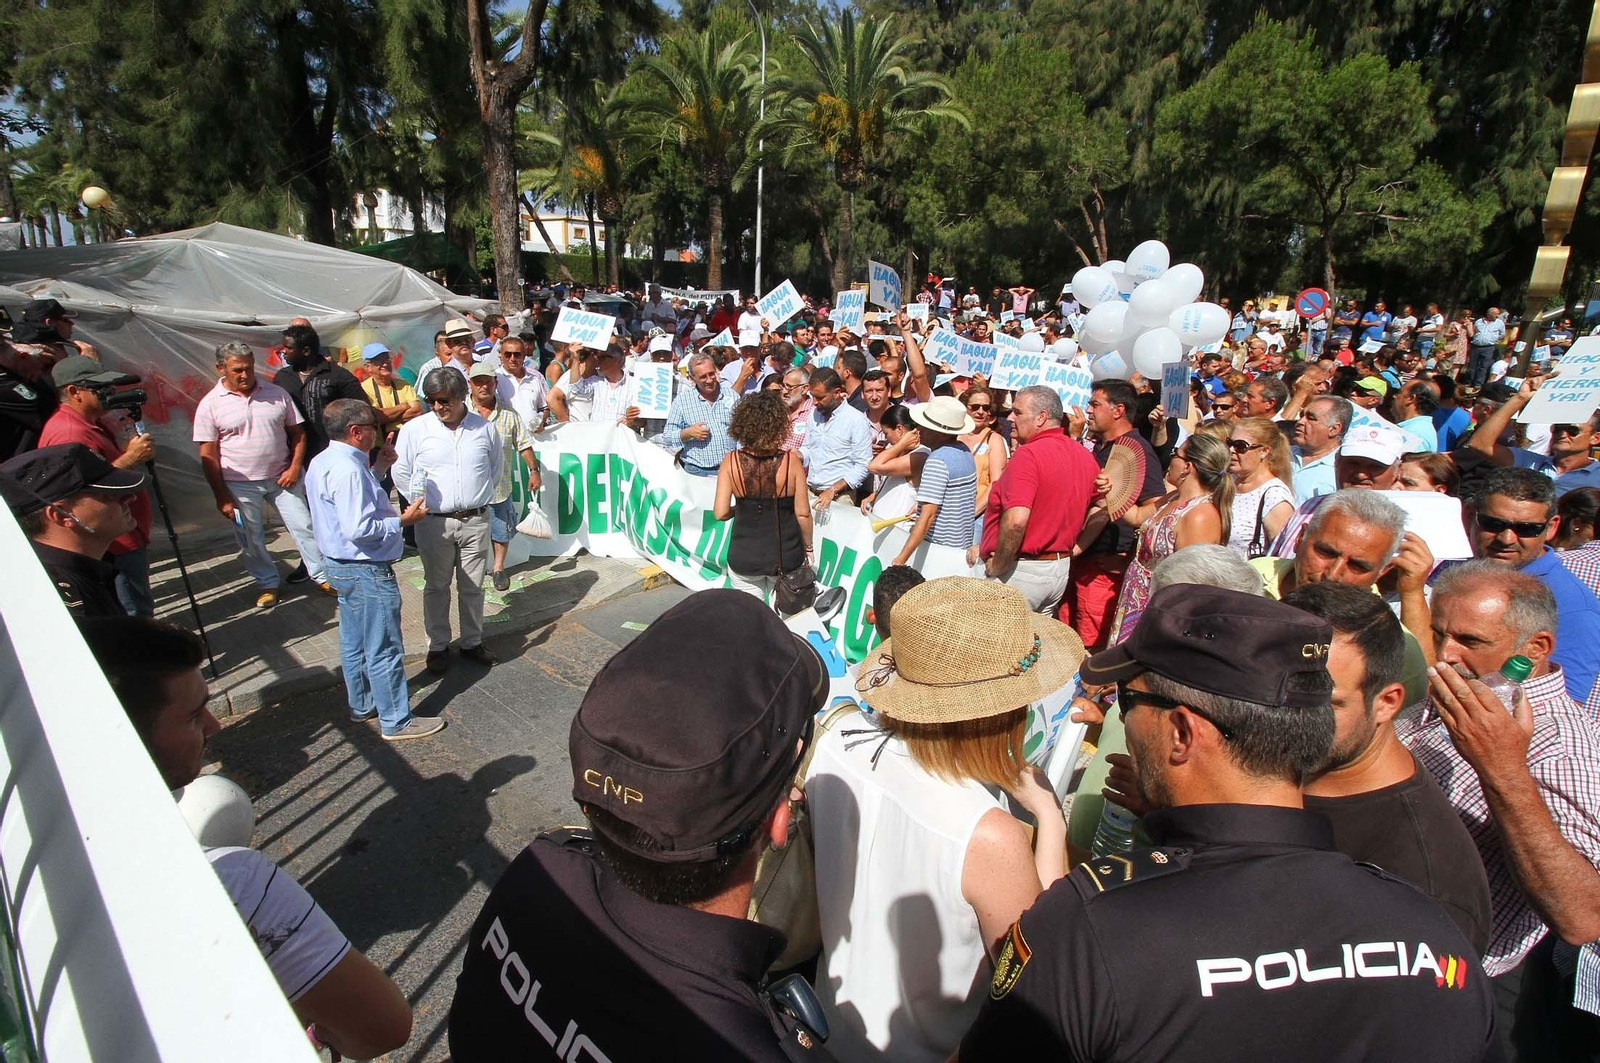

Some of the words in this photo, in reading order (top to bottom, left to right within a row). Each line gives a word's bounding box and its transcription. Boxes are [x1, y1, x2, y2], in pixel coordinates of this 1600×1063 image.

[558, 452, 691, 567] DEFENSA
[584, 768, 644, 805] CNP
[1196, 940, 1444, 998] POLICIA
